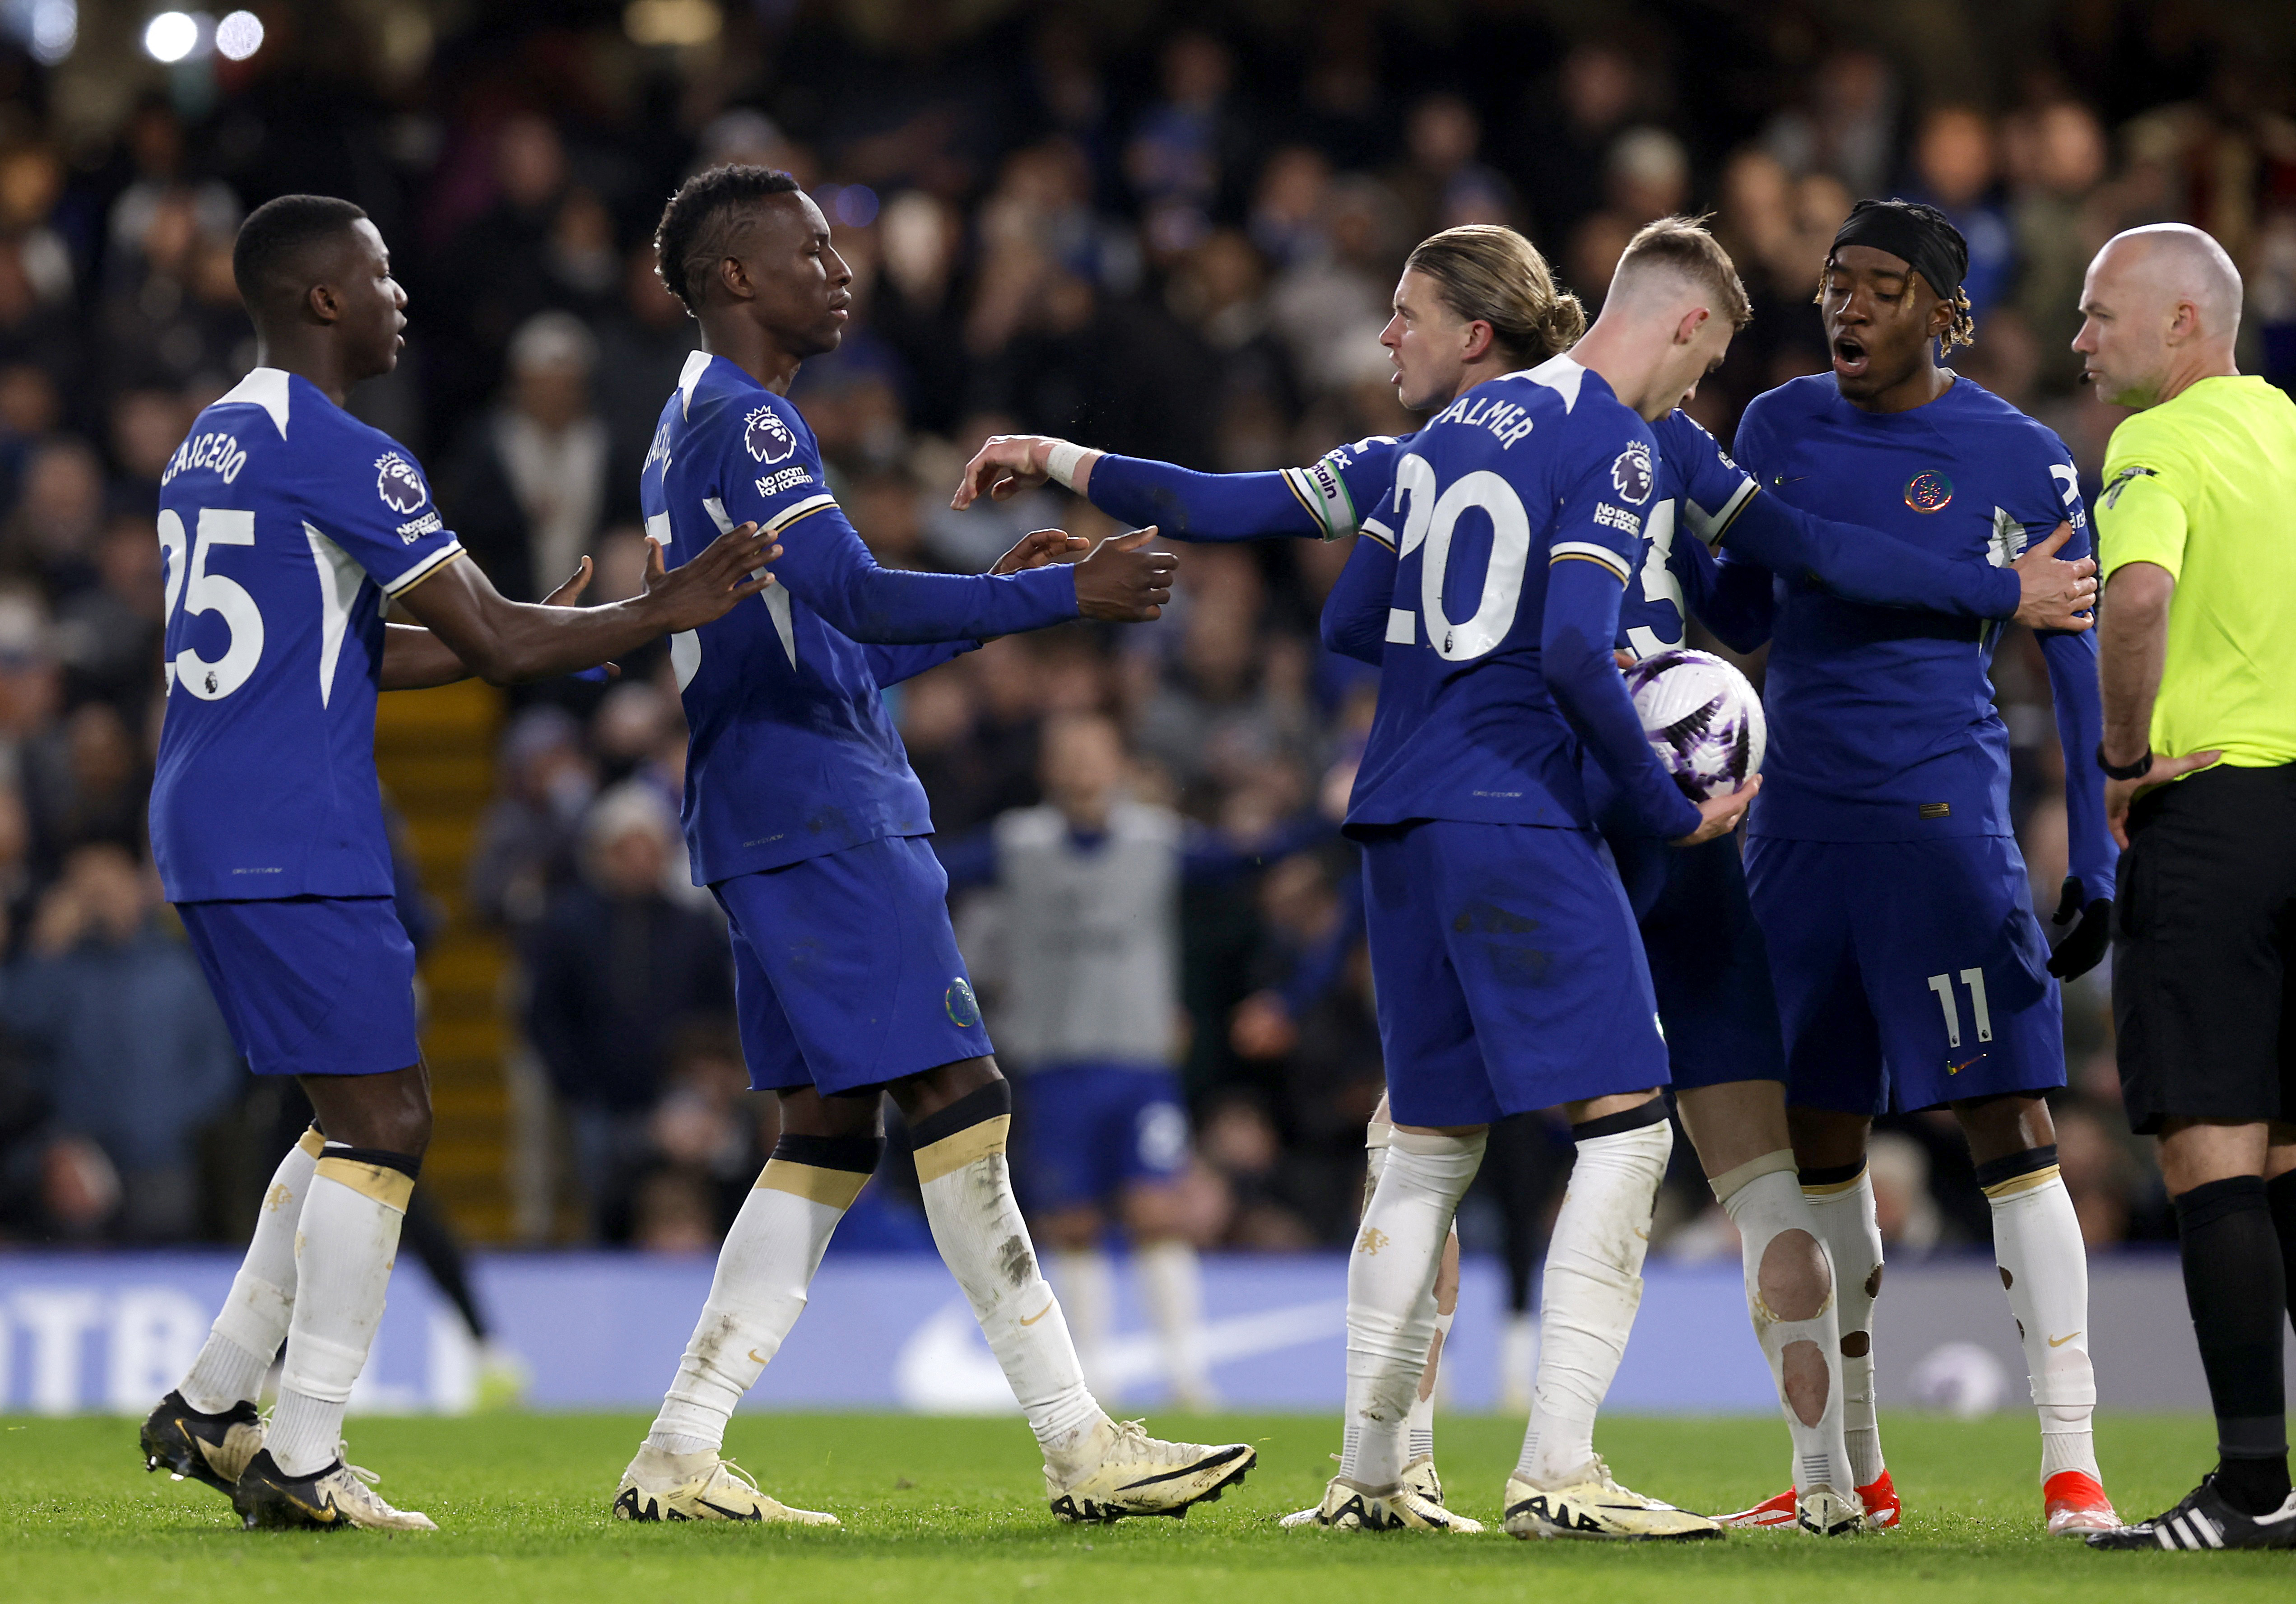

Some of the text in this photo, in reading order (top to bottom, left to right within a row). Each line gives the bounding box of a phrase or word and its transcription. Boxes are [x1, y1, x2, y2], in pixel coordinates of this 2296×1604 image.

[755, 466, 805, 489] No room
[759, 474, 813, 497] for racism
[1593, 513, 1614, 526] for
[1595, 502, 1641, 528] No room
[396, 523, 416, 536] No
[401, 529, 420, 545] for
[1385, 453, 1530, 661] 20
[157, 507, 264, 701] 25
[1928, 967, 1992, 1048] 11
